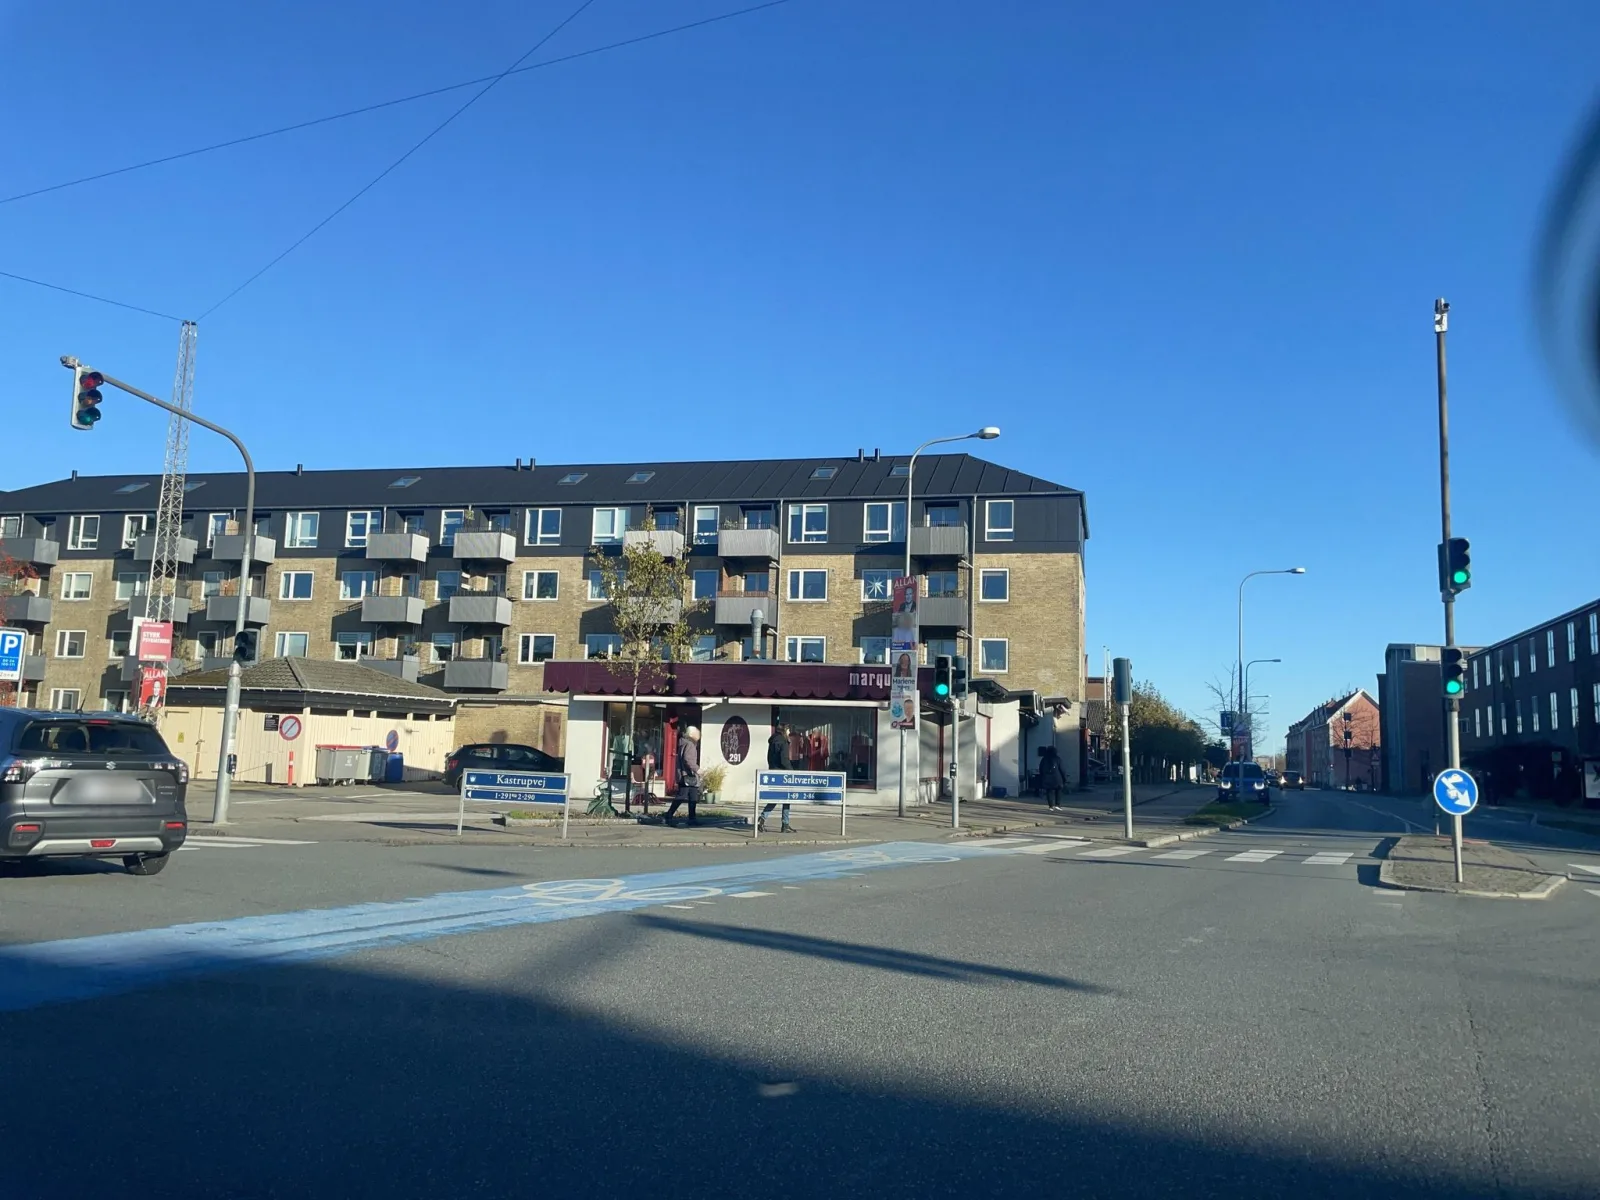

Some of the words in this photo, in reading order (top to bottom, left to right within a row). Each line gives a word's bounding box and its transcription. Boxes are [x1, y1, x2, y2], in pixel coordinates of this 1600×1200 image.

[893, 575, 918, 589] ALLAN
[4, 635, 19, 655] P
[143, 669, 167, 679] ALLAN
[729, 753, 741, 762] 291
[496, 774, 546, 788] Kastrupvej
[783, 774, 829, 787] Saltværksvej
